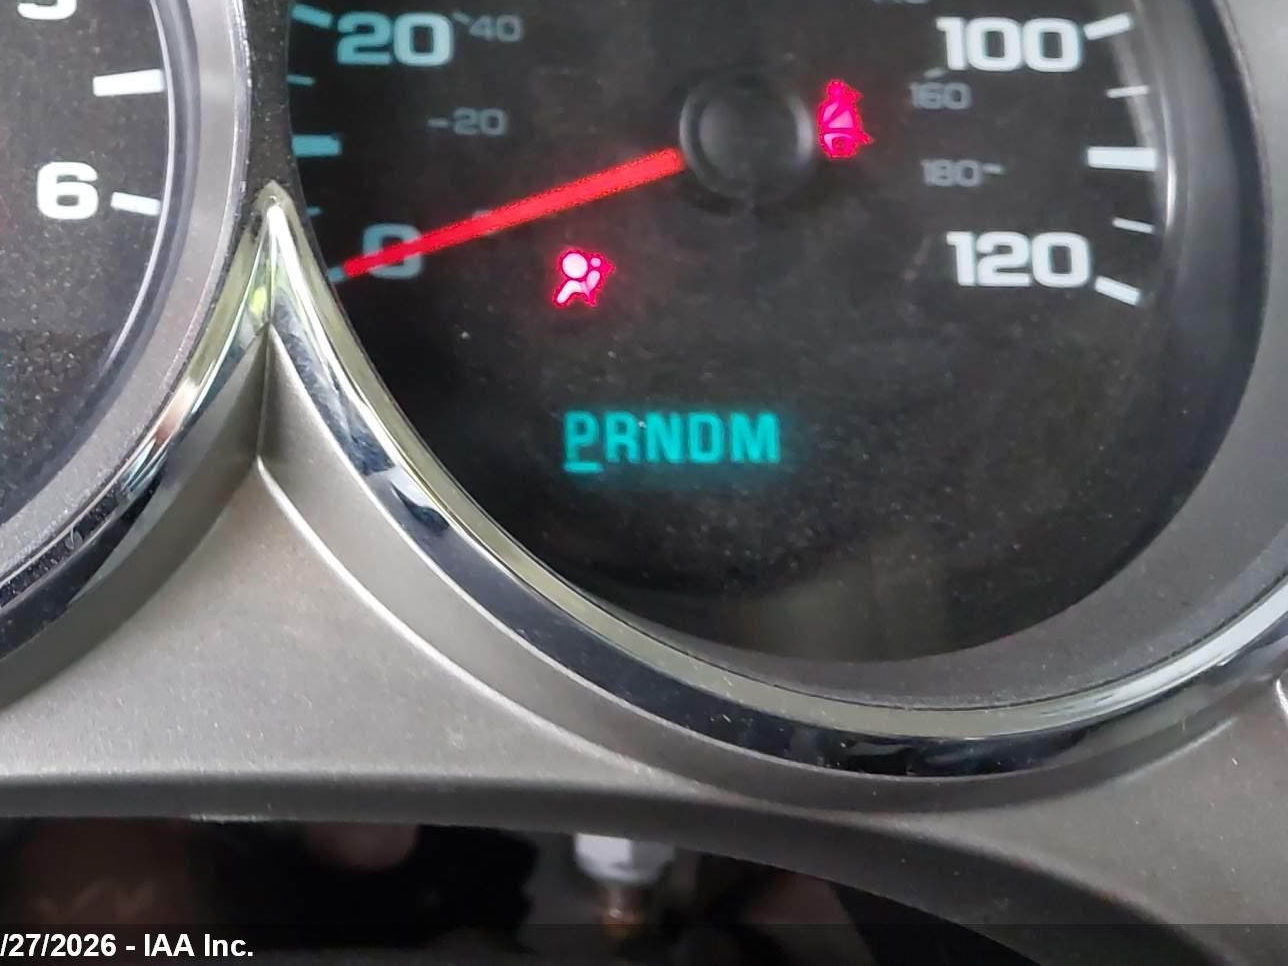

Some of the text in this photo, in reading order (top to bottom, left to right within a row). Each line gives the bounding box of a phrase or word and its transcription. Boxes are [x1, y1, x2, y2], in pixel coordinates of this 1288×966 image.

[337, 13, 453, 66] 20
[468, 15, 523, 41] 40
[937, 19, 1082, 71] 100
[452, 109, 506, 135] 20
[911, 83, 971, 109] 160
[37, 163, 98, 219] 6
[922, 159, 979, 185] 180
[947, 233, 1088, 287] 120
[564, 410, 781, 466] PRNDM
